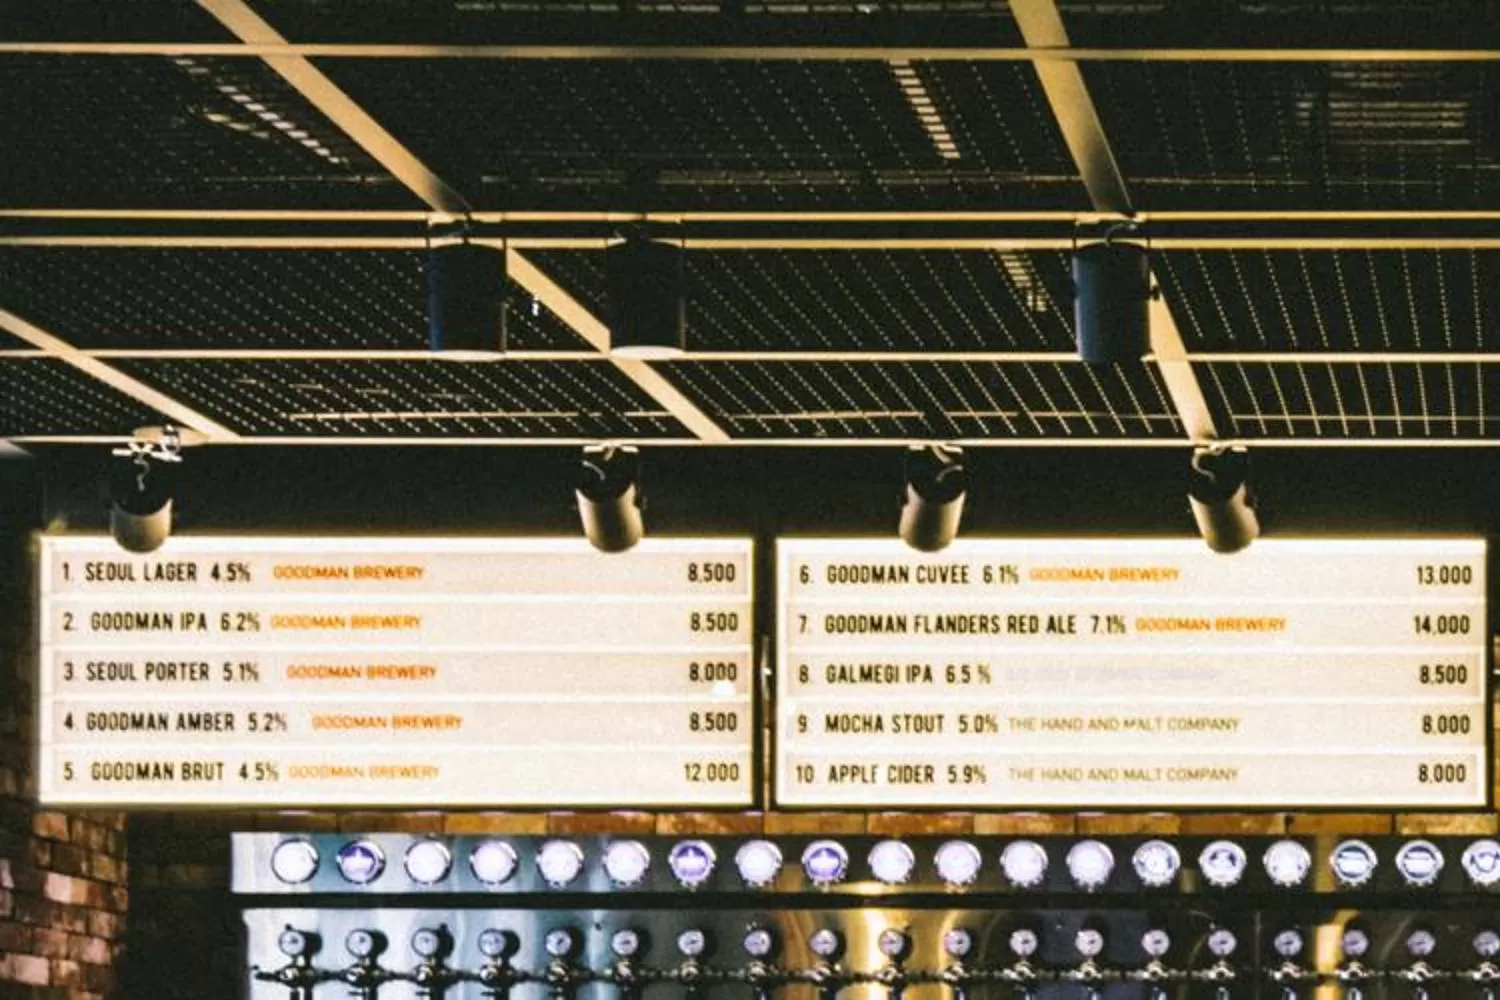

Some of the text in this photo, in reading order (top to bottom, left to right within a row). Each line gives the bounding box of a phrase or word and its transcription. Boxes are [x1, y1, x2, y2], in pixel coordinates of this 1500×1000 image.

[83, 562, 137, 581] SEOUL
[142, 563, 198, 581] LAGER
[271, 566, 349, 579] GOODMAN
[353, 566, 426, 579] BREWERY
[826, 565, 910, 583] GOODMAN
[915, 565, 971, 584] CUVEE
[1028, 569, 1105, 581] GOODMAN
[1108, 568, 1181, 581] BREWERY
[89, 613, 174, 630] GOODMAN
[179, 612, 208, 629] IPA
[269, 616, 346, 628] GOODMAN
[349, 616, 423, 628] BREWERY
[824, 615, 908, 633] GOODMAN
[912, 615, 1001, 634] FLANDERS
[1006, 615, 1040, 634] RED
[1045, 615, 1077, 634] ALE
[1134, 618, 1211, 631] GOODMAN
[1214, 618, 1288, 631] BREWERY
[85, 662, 138, 681] SEOUL
[143, 662, 210, 680] PORTER
[285, 666, 361, 678] GOODMAN
[365, 666, 438, 679] BREWERY
[825, 665, 901, 683] GALMEGI
[905, 665, 934, 682] IPA
[84, 713, 169, 730] GOODMAN
[174, 713, 236, 731] AMBER
[311, 716, 387, 729] GOODMAN
[390, 715, 463, 728] BREWERY
[825, 715, 886, 733] MOCHA
[890, 714, 945, 733] STOUT
[1008, 717, 1037, 731] THE
[1040, 718, 1084, 731] HAND
[1087, 717, 1121, 731] AND
[1123, 718, 1162, 730] MALT
[1165, 718, 1241, 730] COMPANY
[89, 763, 175, 780] GOODMAN
[180, 762, 225, 780] BRUT
[287, 767, 365, 777] GOODMAN
[368, 766, 440, 778] BREWERY
[827, 765, 879, 783] APPLE
[886, 765, 935, 784] CIDER
[1009, 768, 1037, 781] THE
[1040, 768, 1084, 781] HAND
[1087, 768, 1120, 781] AND
[1123, 769, 1162, 780] MALT
[1165, 768, 1240, 780] COMPANY
